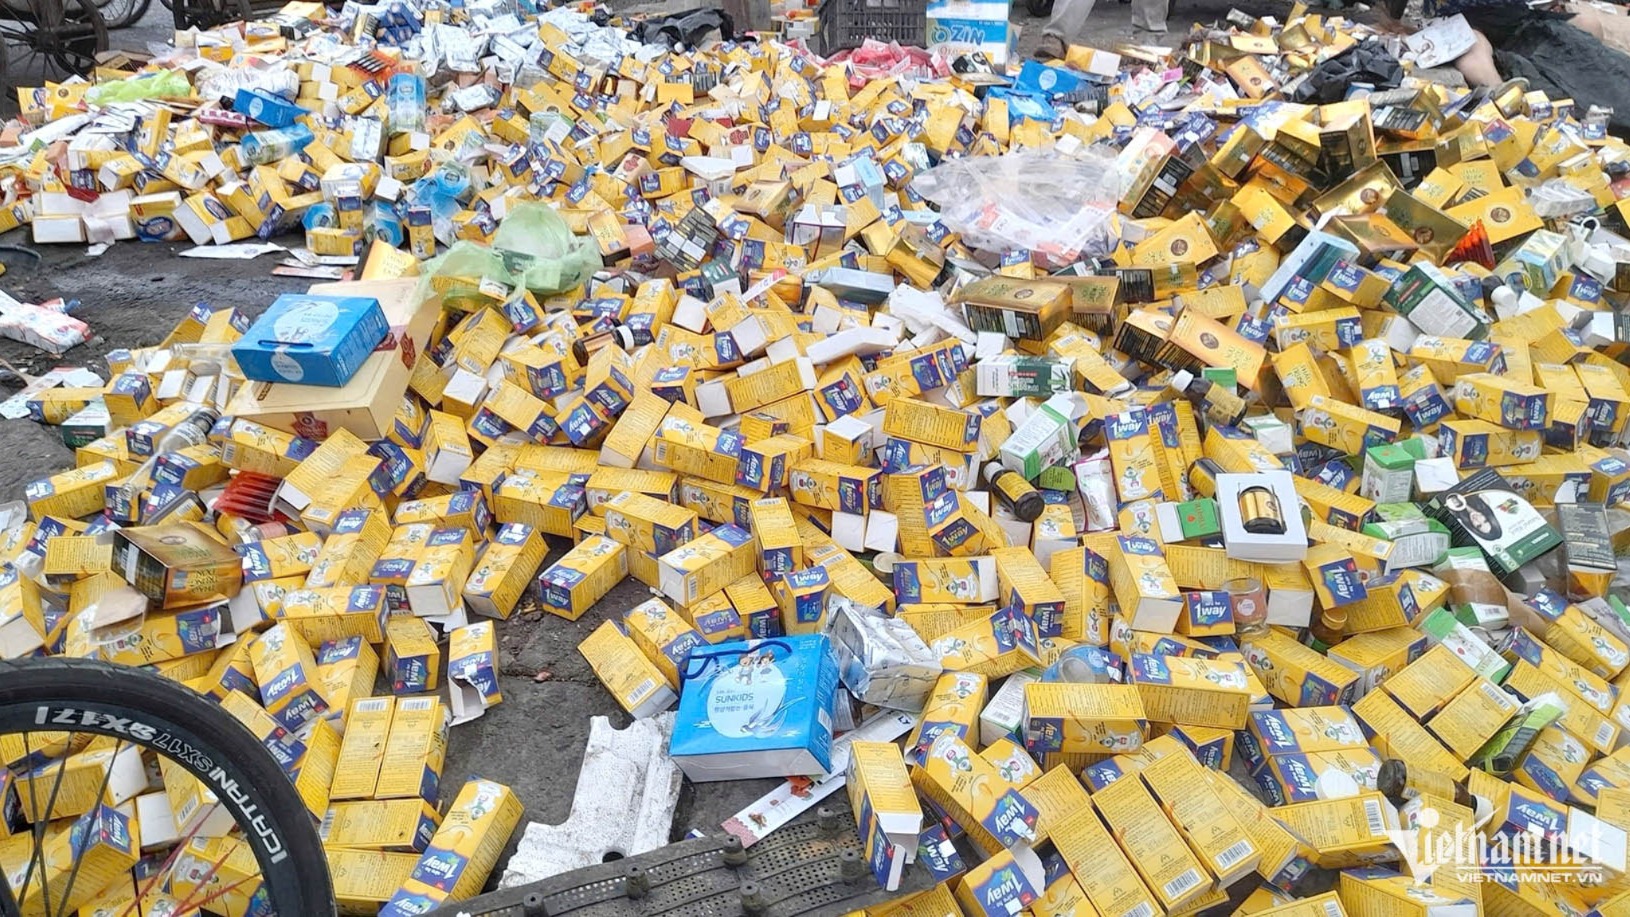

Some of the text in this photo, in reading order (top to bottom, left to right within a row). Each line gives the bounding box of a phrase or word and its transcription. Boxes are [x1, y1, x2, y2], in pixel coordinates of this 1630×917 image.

[1336, 270, 1357, 287] 1way
[1288, 284, 1308, 304] 1way
[1576, 284, 1597, 300] 1way
[1240, 322, 1264, 338] 1way
[720, 334, 732, 361] 1way
[597, 388, 621, 410] 1way
[832, 389, 848, 415] 1way
[1367, 390, 1397, 402] 1way
[569, 411, 592, 431] 1way
[1148, 414, 1173, 427] 1way
[1415, 406, 1442, 428] 1way
[1530, 399, 1543, 427] 1way
[1593, 402, 1613, 427] 1way
[478, 415, 500, 437] 1way
[535, 418, 553, 440] 1way
[1110, 421, 1143, 440] 1way
[130, 442, 153, 457] 1way
[719, 436, 738, 453] 1way
[156, 466, 180, 485] 1way
[745, 454, 759, 483] 1way
[846, 483, 856, 511] 1way
[924, 479, 945, 498] 1way
[337, 513, 363, 530] 1way
[929, 506, 954, 528] 1way
[38, 521, 64, 553] 1way
[942, 526, 968, 546] 1way
[1124, 540, 1156, 553] 1way
[251, 546, 267, 577] 1way
[379, 560, 412, 571] 1way
[774, 551, 787, 577] 1way
[792, 573, 824, 587] 1way
[1330, 566, 1351, 599] 1way
[355, 585, 373, 609] 1way
[544, 587, 569, 604] 1way
[1038, 606, 1055, 633] 1way
[1194, 603, 1227, 617] 1way
[703, 615, 733, 628] 1way
[999, 616, 1012, 647] 1way
[1022, 615, 1036, 646] 1way
[325, 646, 355, 664] 1way
[672, 637, 700, 655] 1way
[406, 659, 422, 687] 1way
[1148, 658, 1161, 679] 1way
[267, 671, 298, 697] 1way
[286, 692, 318, 720] 1way
[715, 693, 754, 703] SUNKIDS
[1266, 715, 1292, 747] 1way
[153, 735, 213, 772] SX17
[266, 739, 293, 765] 1way
[1242, 732, 1259, 765] 1way
[1289, 758, 1315, 796] 1way
[1264, 774, 1282, 806] 1way
[995, 798, 1026, 833] 1way
[1515, 804, 1558, 830] 1way
[111, 815, 128, 848] 1way
[929, 835, 949, 872] 1way
[422, 855, 458, 880] 1way
[987, 873, 1022, 906] 1way
[395, 898, 432, 914] 1way
